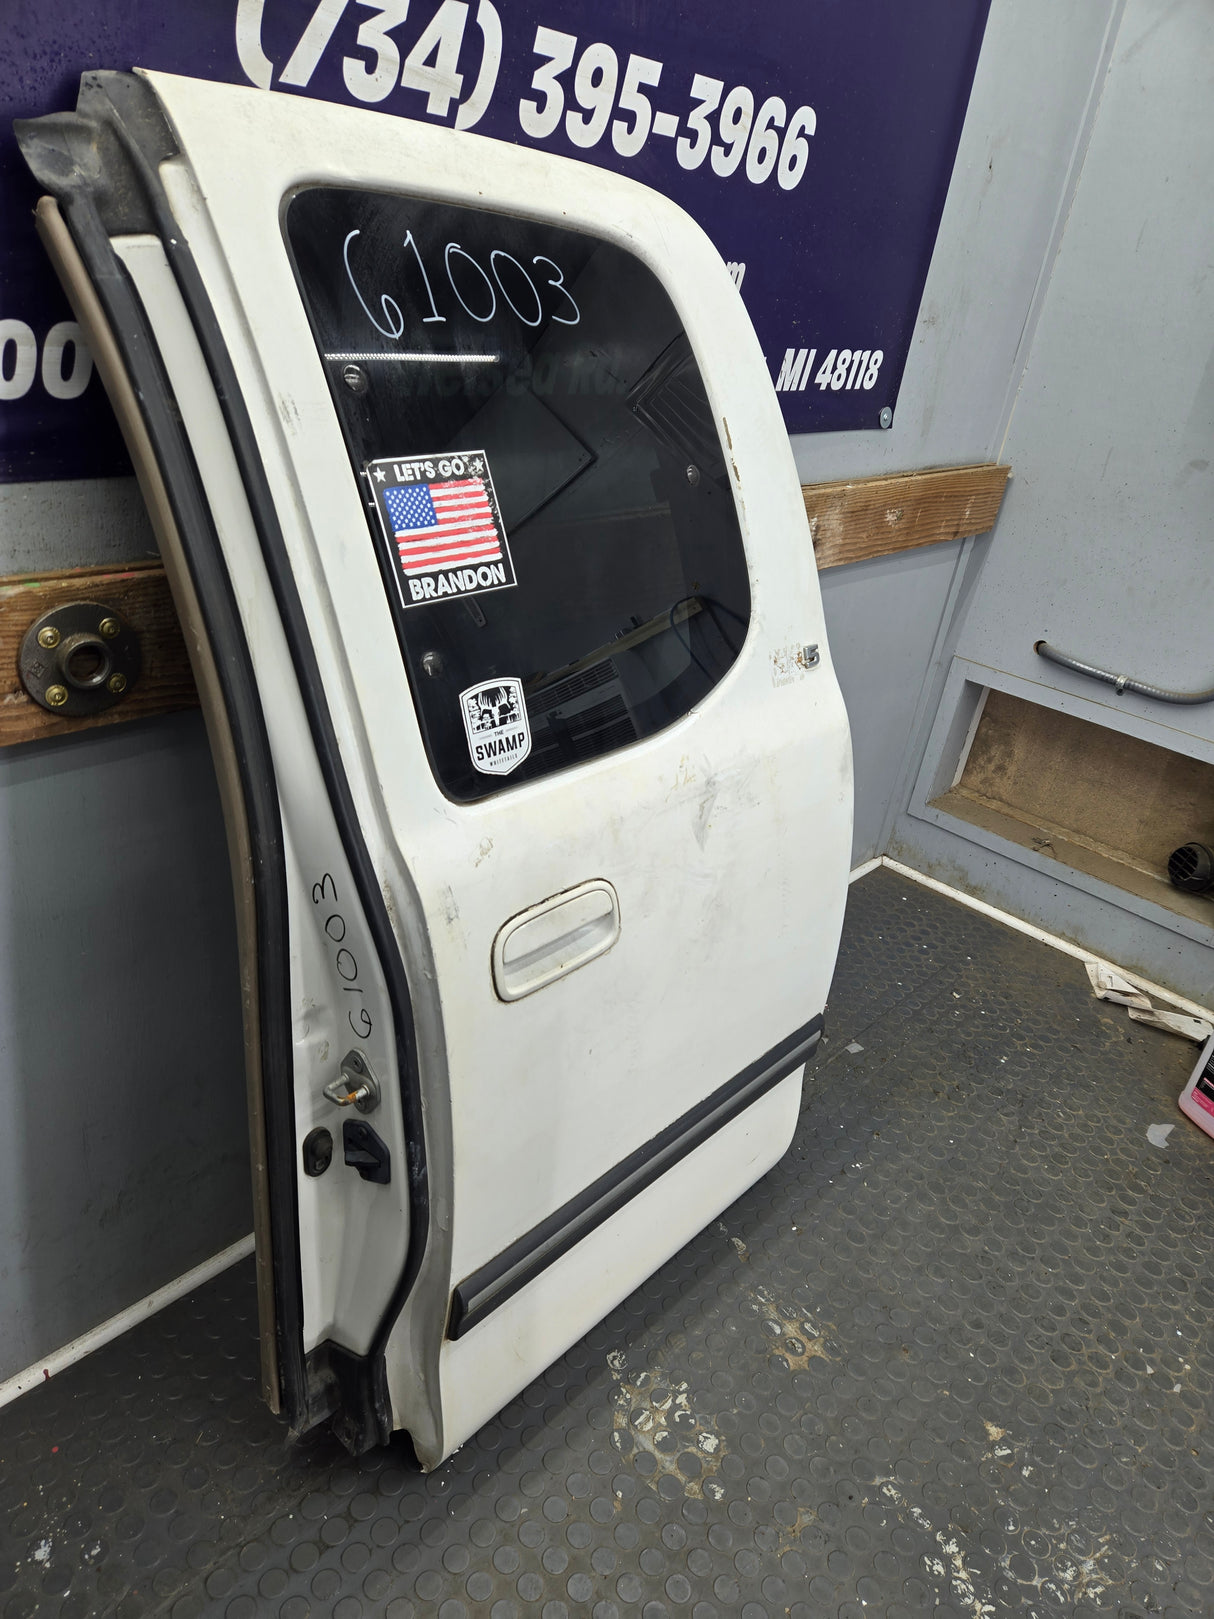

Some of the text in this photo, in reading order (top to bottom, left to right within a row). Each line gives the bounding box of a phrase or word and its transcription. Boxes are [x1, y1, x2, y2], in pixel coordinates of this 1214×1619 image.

[518, 26, 818, 191] 395-3966
[343, 229, 581, 340] 61003
[775, 348, 884, 392] MI 48118
[393, 458, 465, 483] LET'S GO
[407, 562, 507, 602] BRANDON
[475, 731, 526, 762] SWAMP
[493, 729, 505, 737] THE
[312, 872, 373, 1039] 61003
